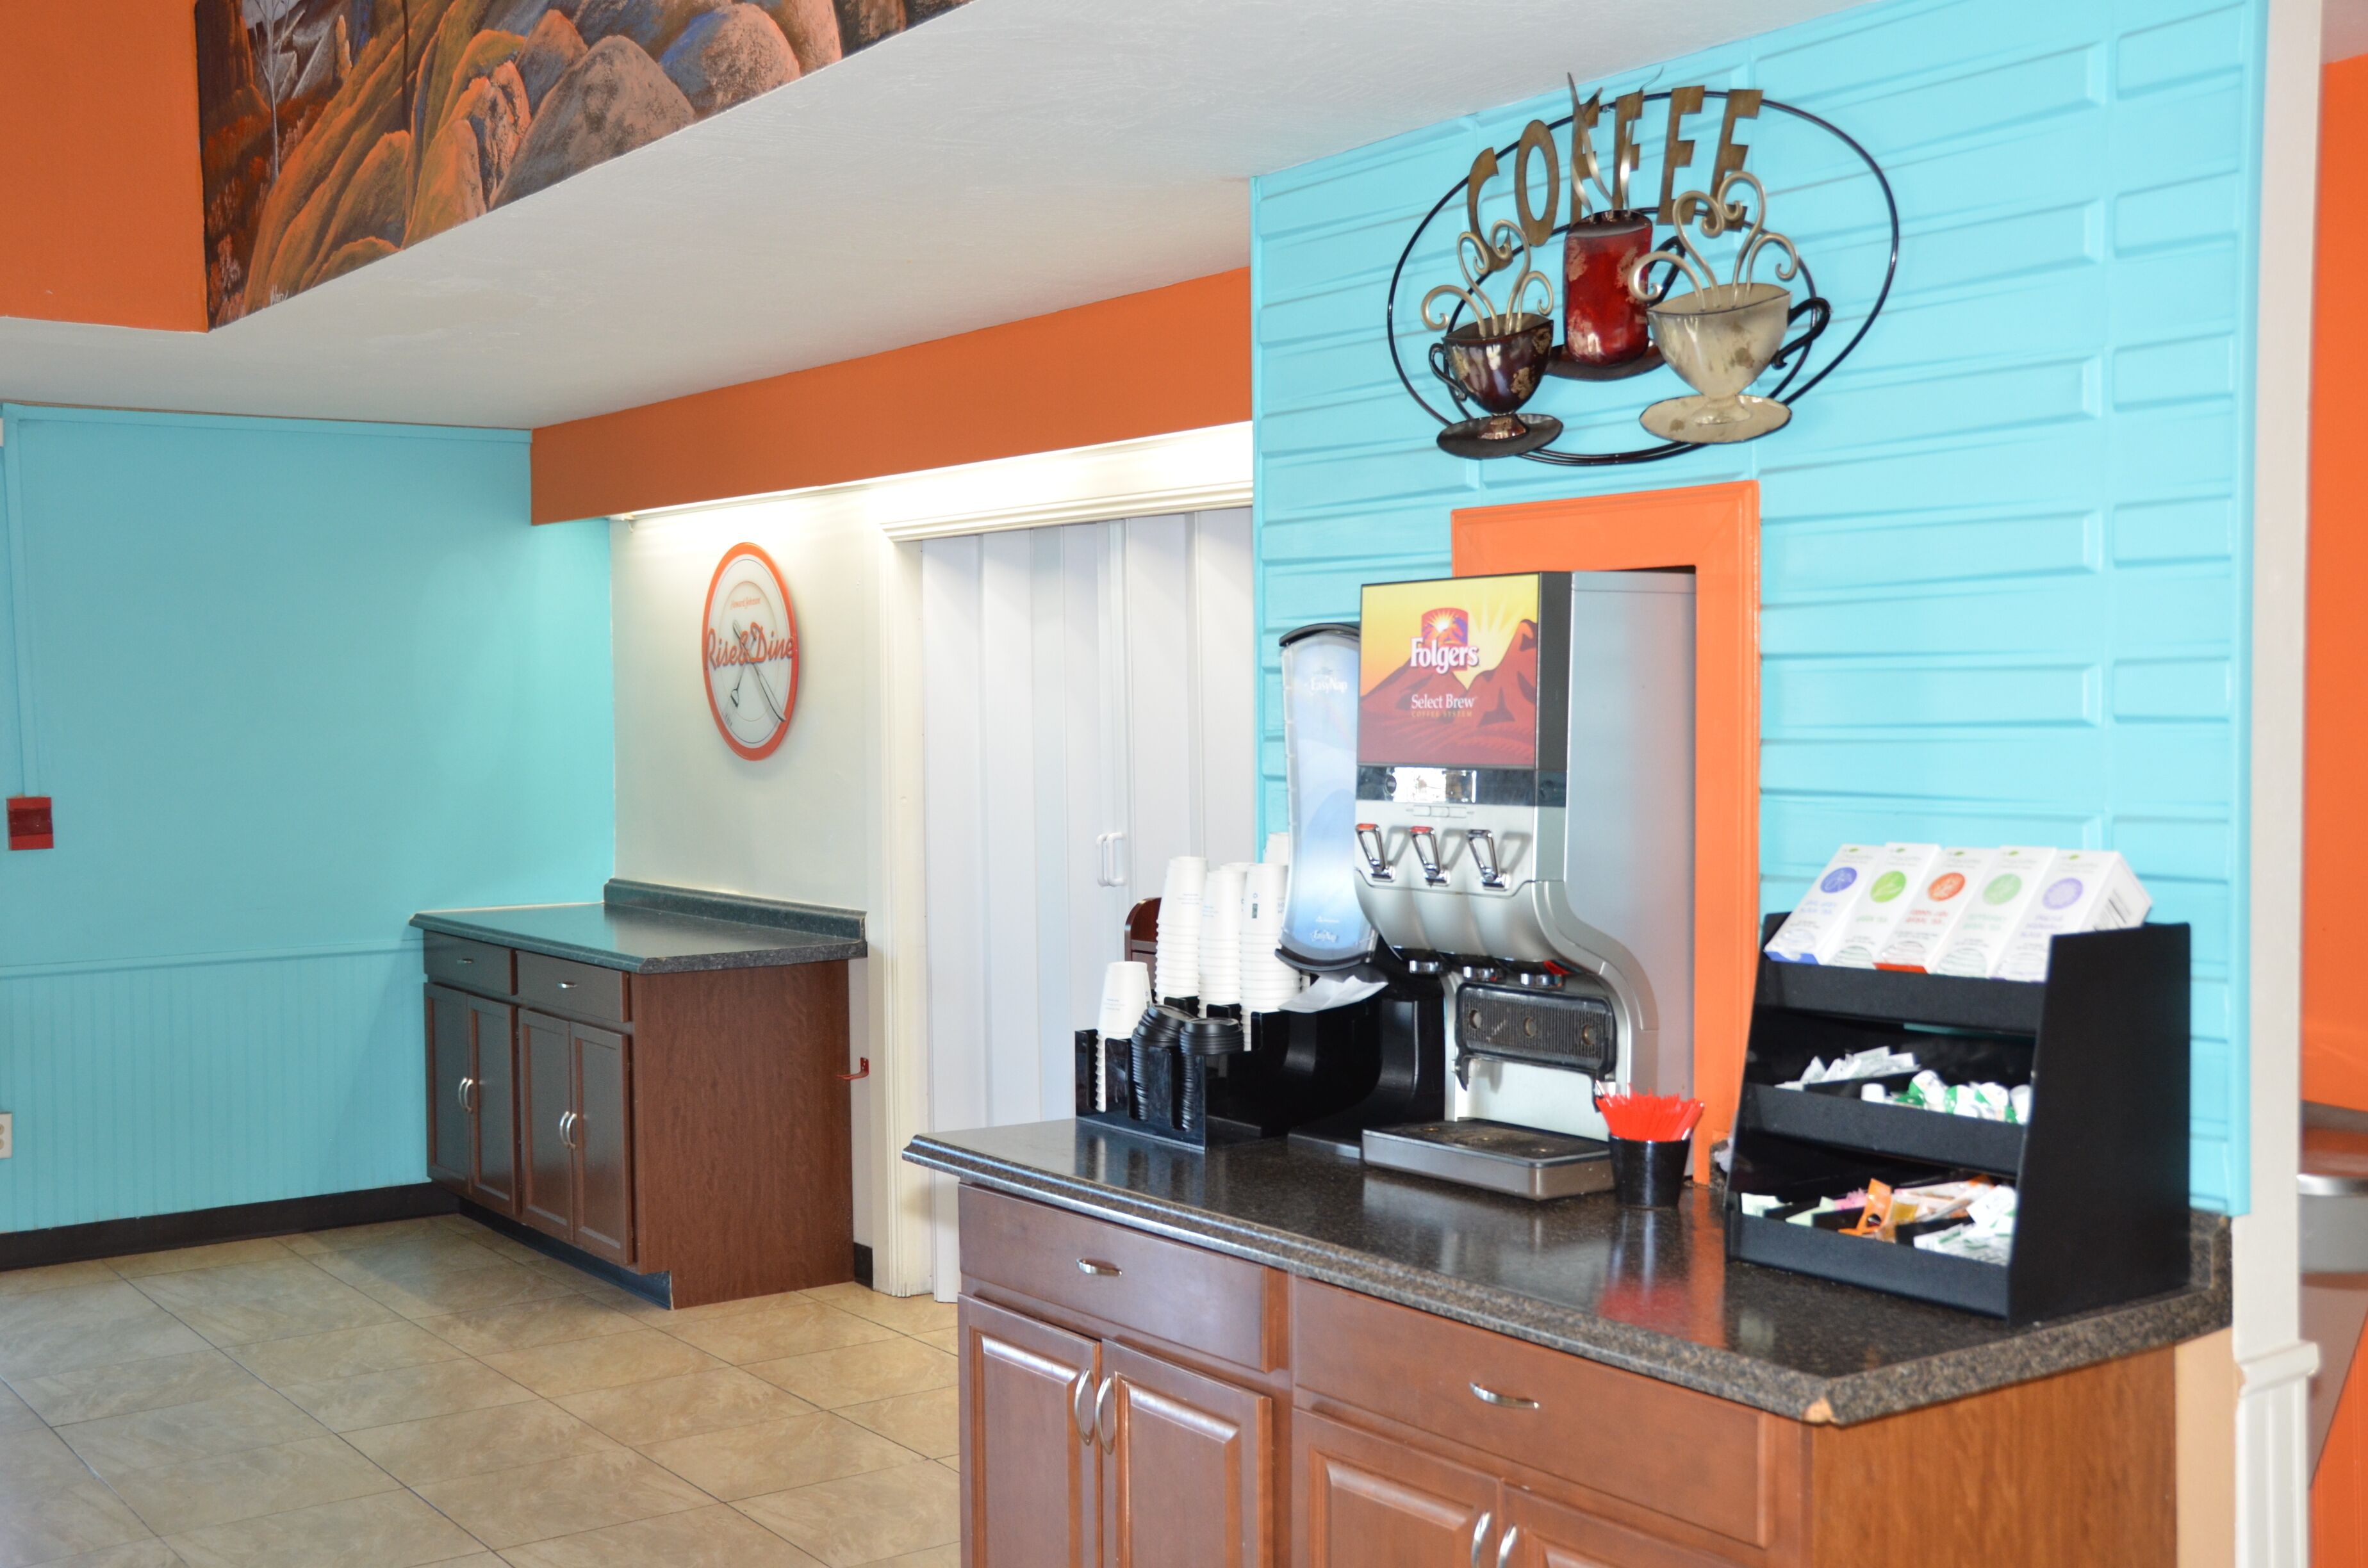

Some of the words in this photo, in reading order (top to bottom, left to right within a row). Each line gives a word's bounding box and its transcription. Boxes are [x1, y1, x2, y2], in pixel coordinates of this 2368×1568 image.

[1467, 85, 1763, 272] COFFEE
[1410, 637, 1479, 674] Folgers
[1411, 694, 1442, 709] Select
[1446, 694, 1474, 708] Brew
